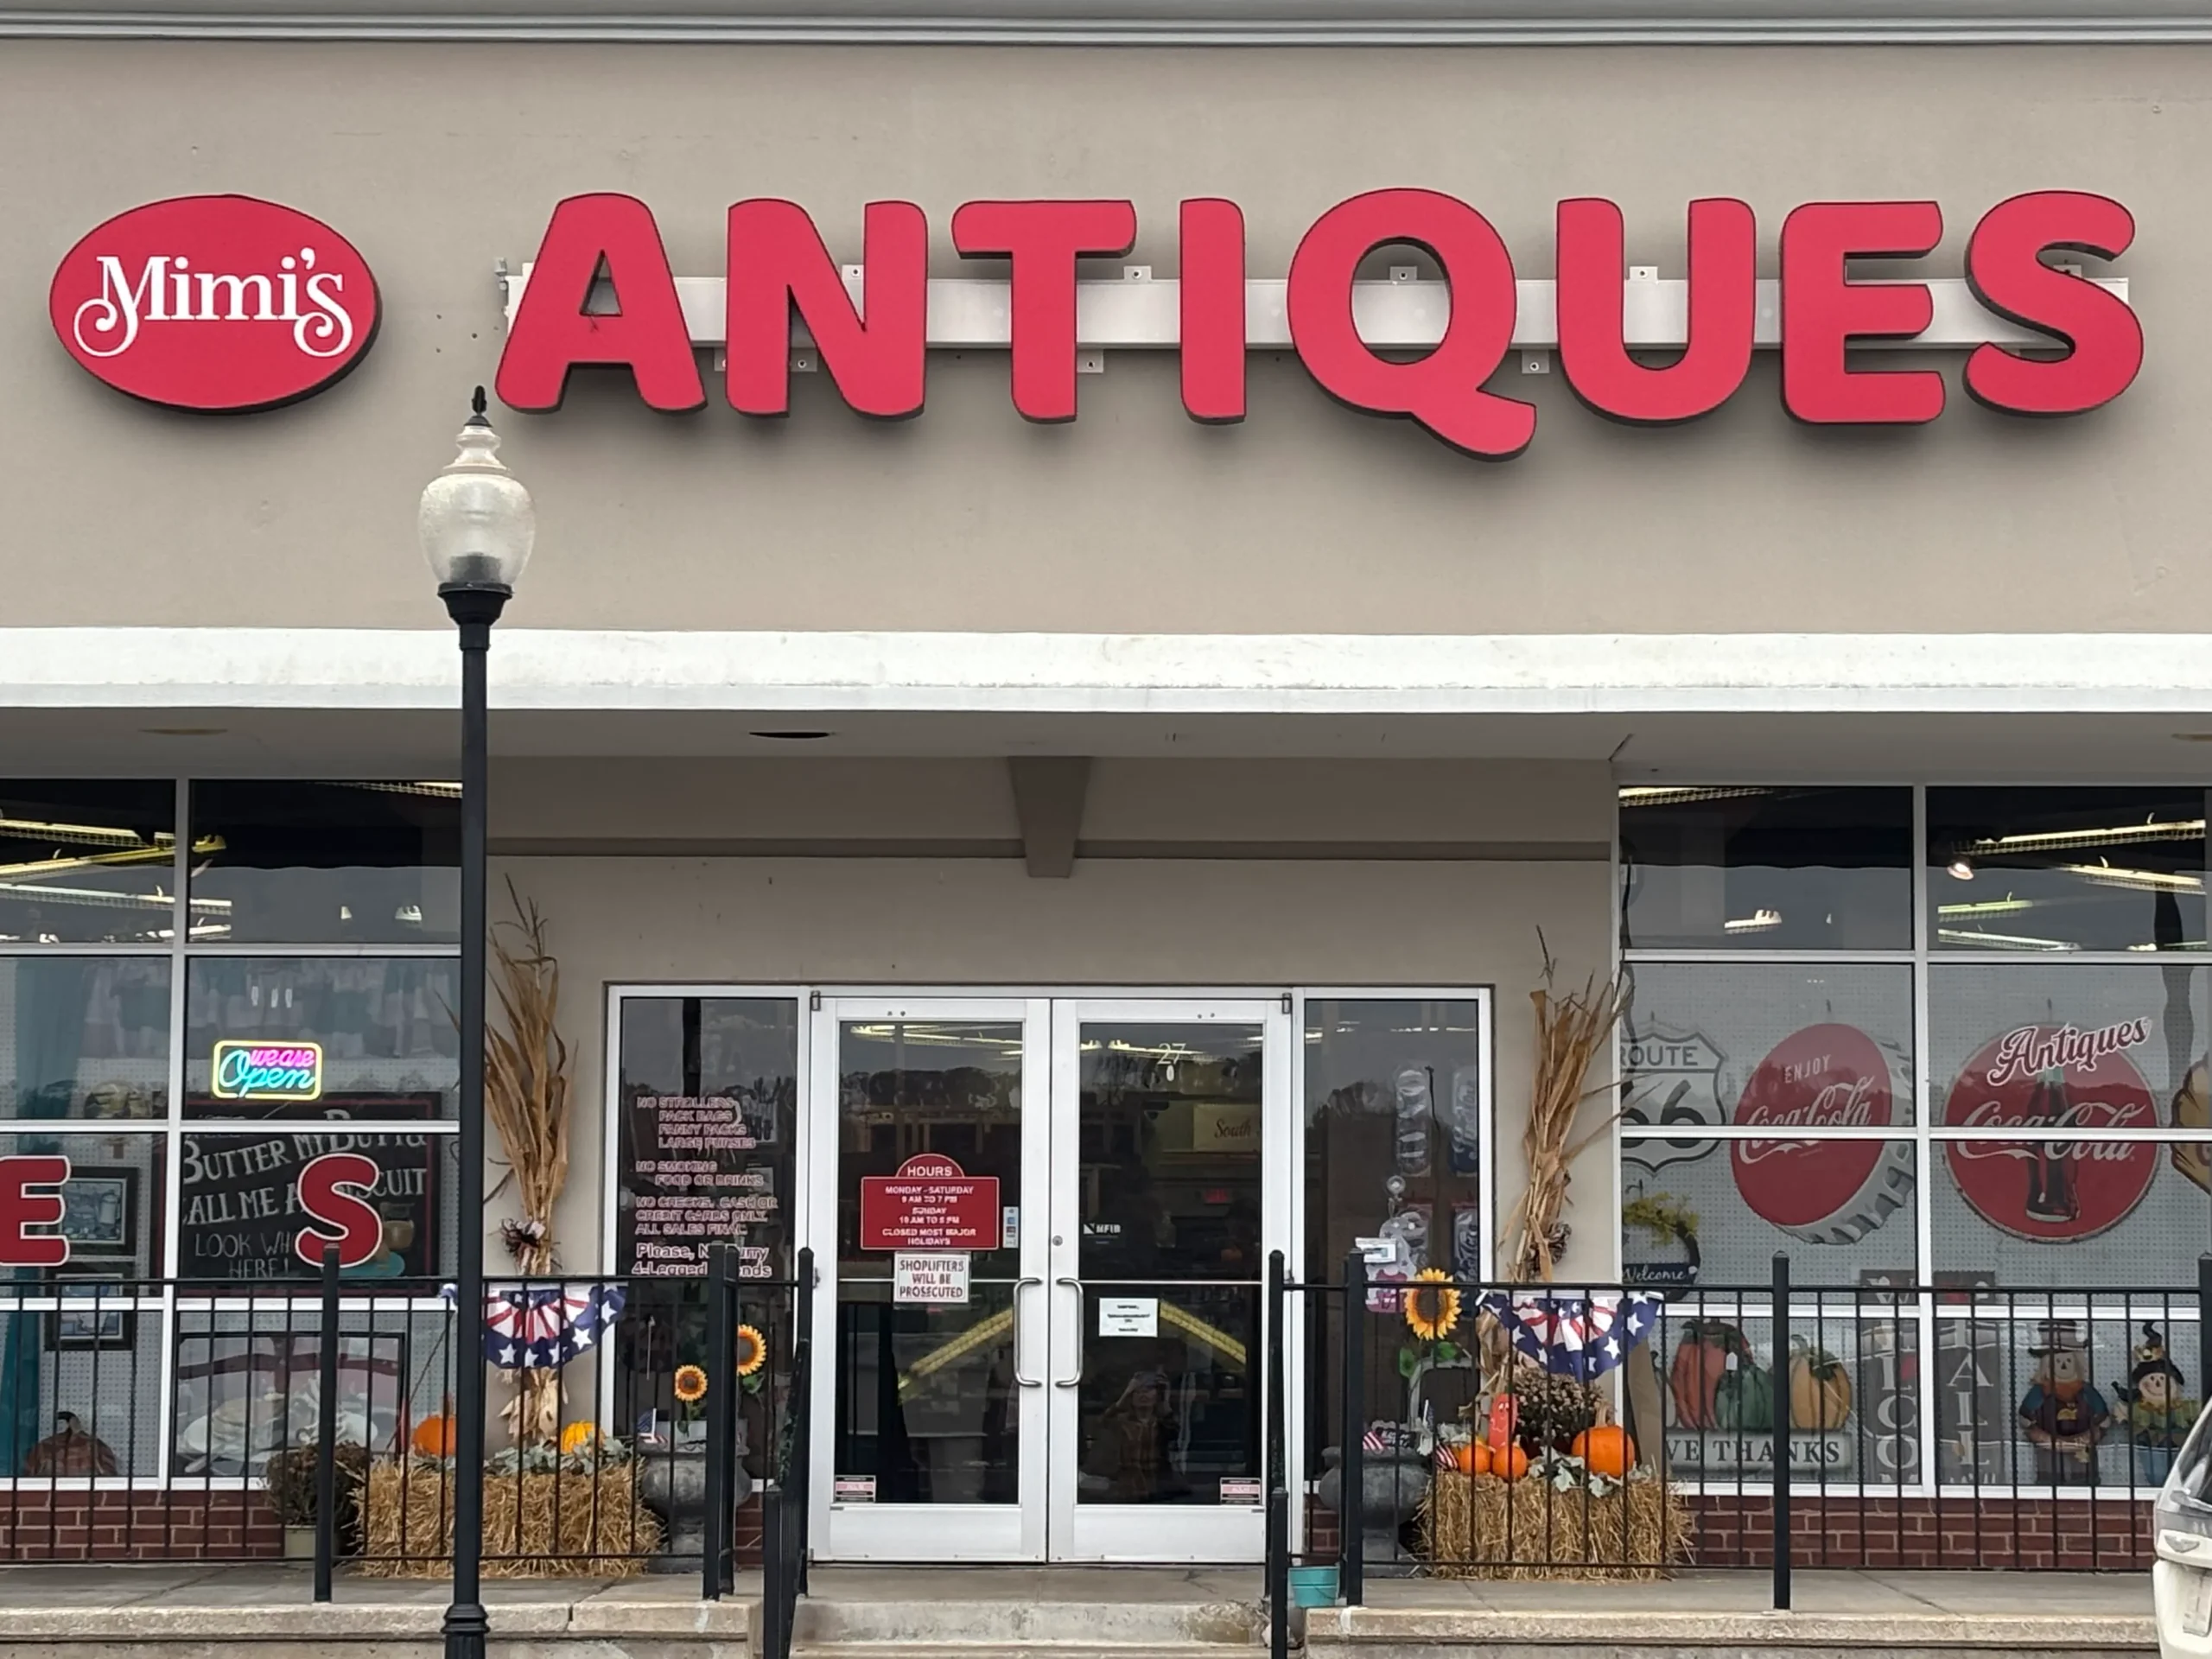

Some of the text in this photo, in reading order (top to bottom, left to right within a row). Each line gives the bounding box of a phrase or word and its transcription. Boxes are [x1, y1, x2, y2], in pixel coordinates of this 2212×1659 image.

[73, 247, 353, 358] Mimi's
[494, 188, 2145, 462] ANTIQUES
[1157, 1042, 1186, 1065] 27
[1987, 1017, 2152, 1086] Antiques
[219, 1049, 316, 1097] Open
[1784, 1054, 1831, 1084] ENJOY
[637, 1096, 657, 1109] NO
[183, 1139, 292, 1184] BUTTER
[907, 1166, 952, 1177] HOURS
[885, 1185, 922, 1194] MONDAY
[929, 1185, 974, 1194] SATURDAY
[182, 1193, 237, 1225] ALL
[238, 1187, 279, 1220] ME
[635, 1224, 661, 1236] ALL
[663, 1224, 705, 1236] SALES
[195, 1233, 253, 1258] LOOK
[899, 1259, 964, 1272] SHOPLIFTERS
[912, 1273, 951, 1285] WILL BE
[899, 1286, 963, 1298] PROSECUTED
